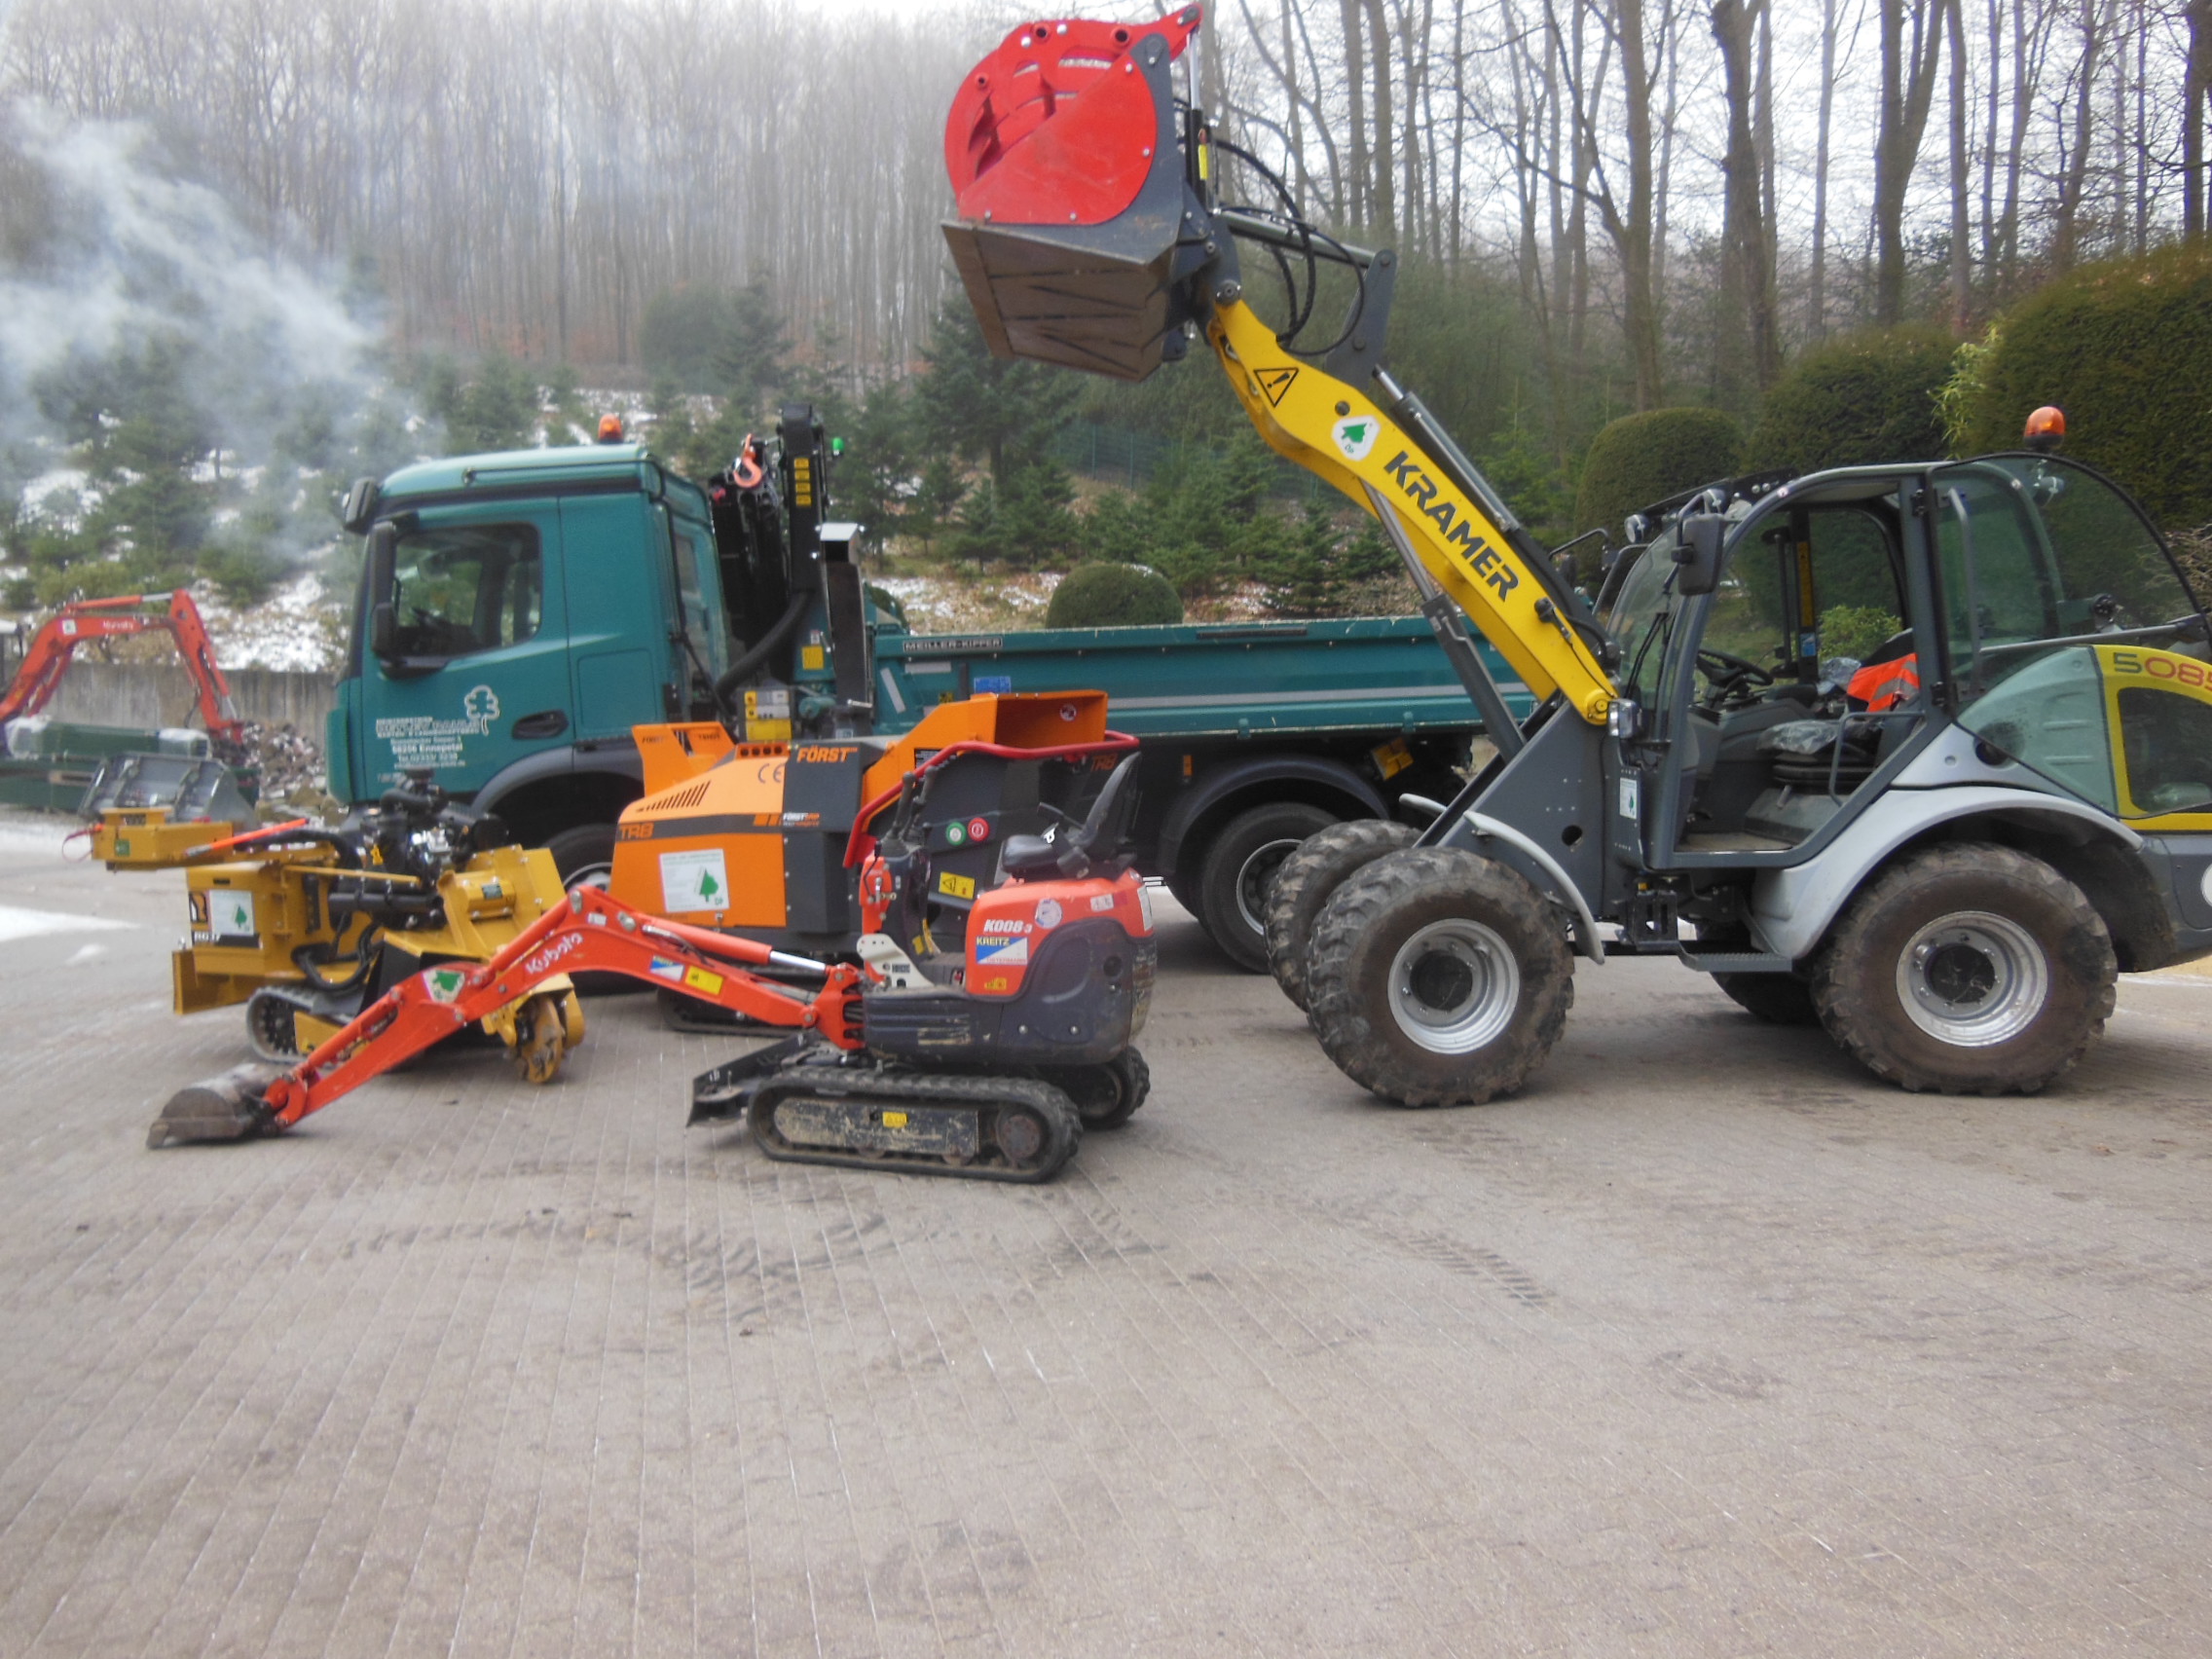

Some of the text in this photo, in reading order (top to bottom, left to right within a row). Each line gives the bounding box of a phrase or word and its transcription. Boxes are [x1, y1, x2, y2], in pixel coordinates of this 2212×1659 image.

[1383, 451, 1519, 602] KRAMER
[2114, 652, 2212, 691] 508
[796, 745, 850, 763] FÖRST
[526, 932, 584, 975] Kubota
[977, 937, 1011, 946] KREITZ
